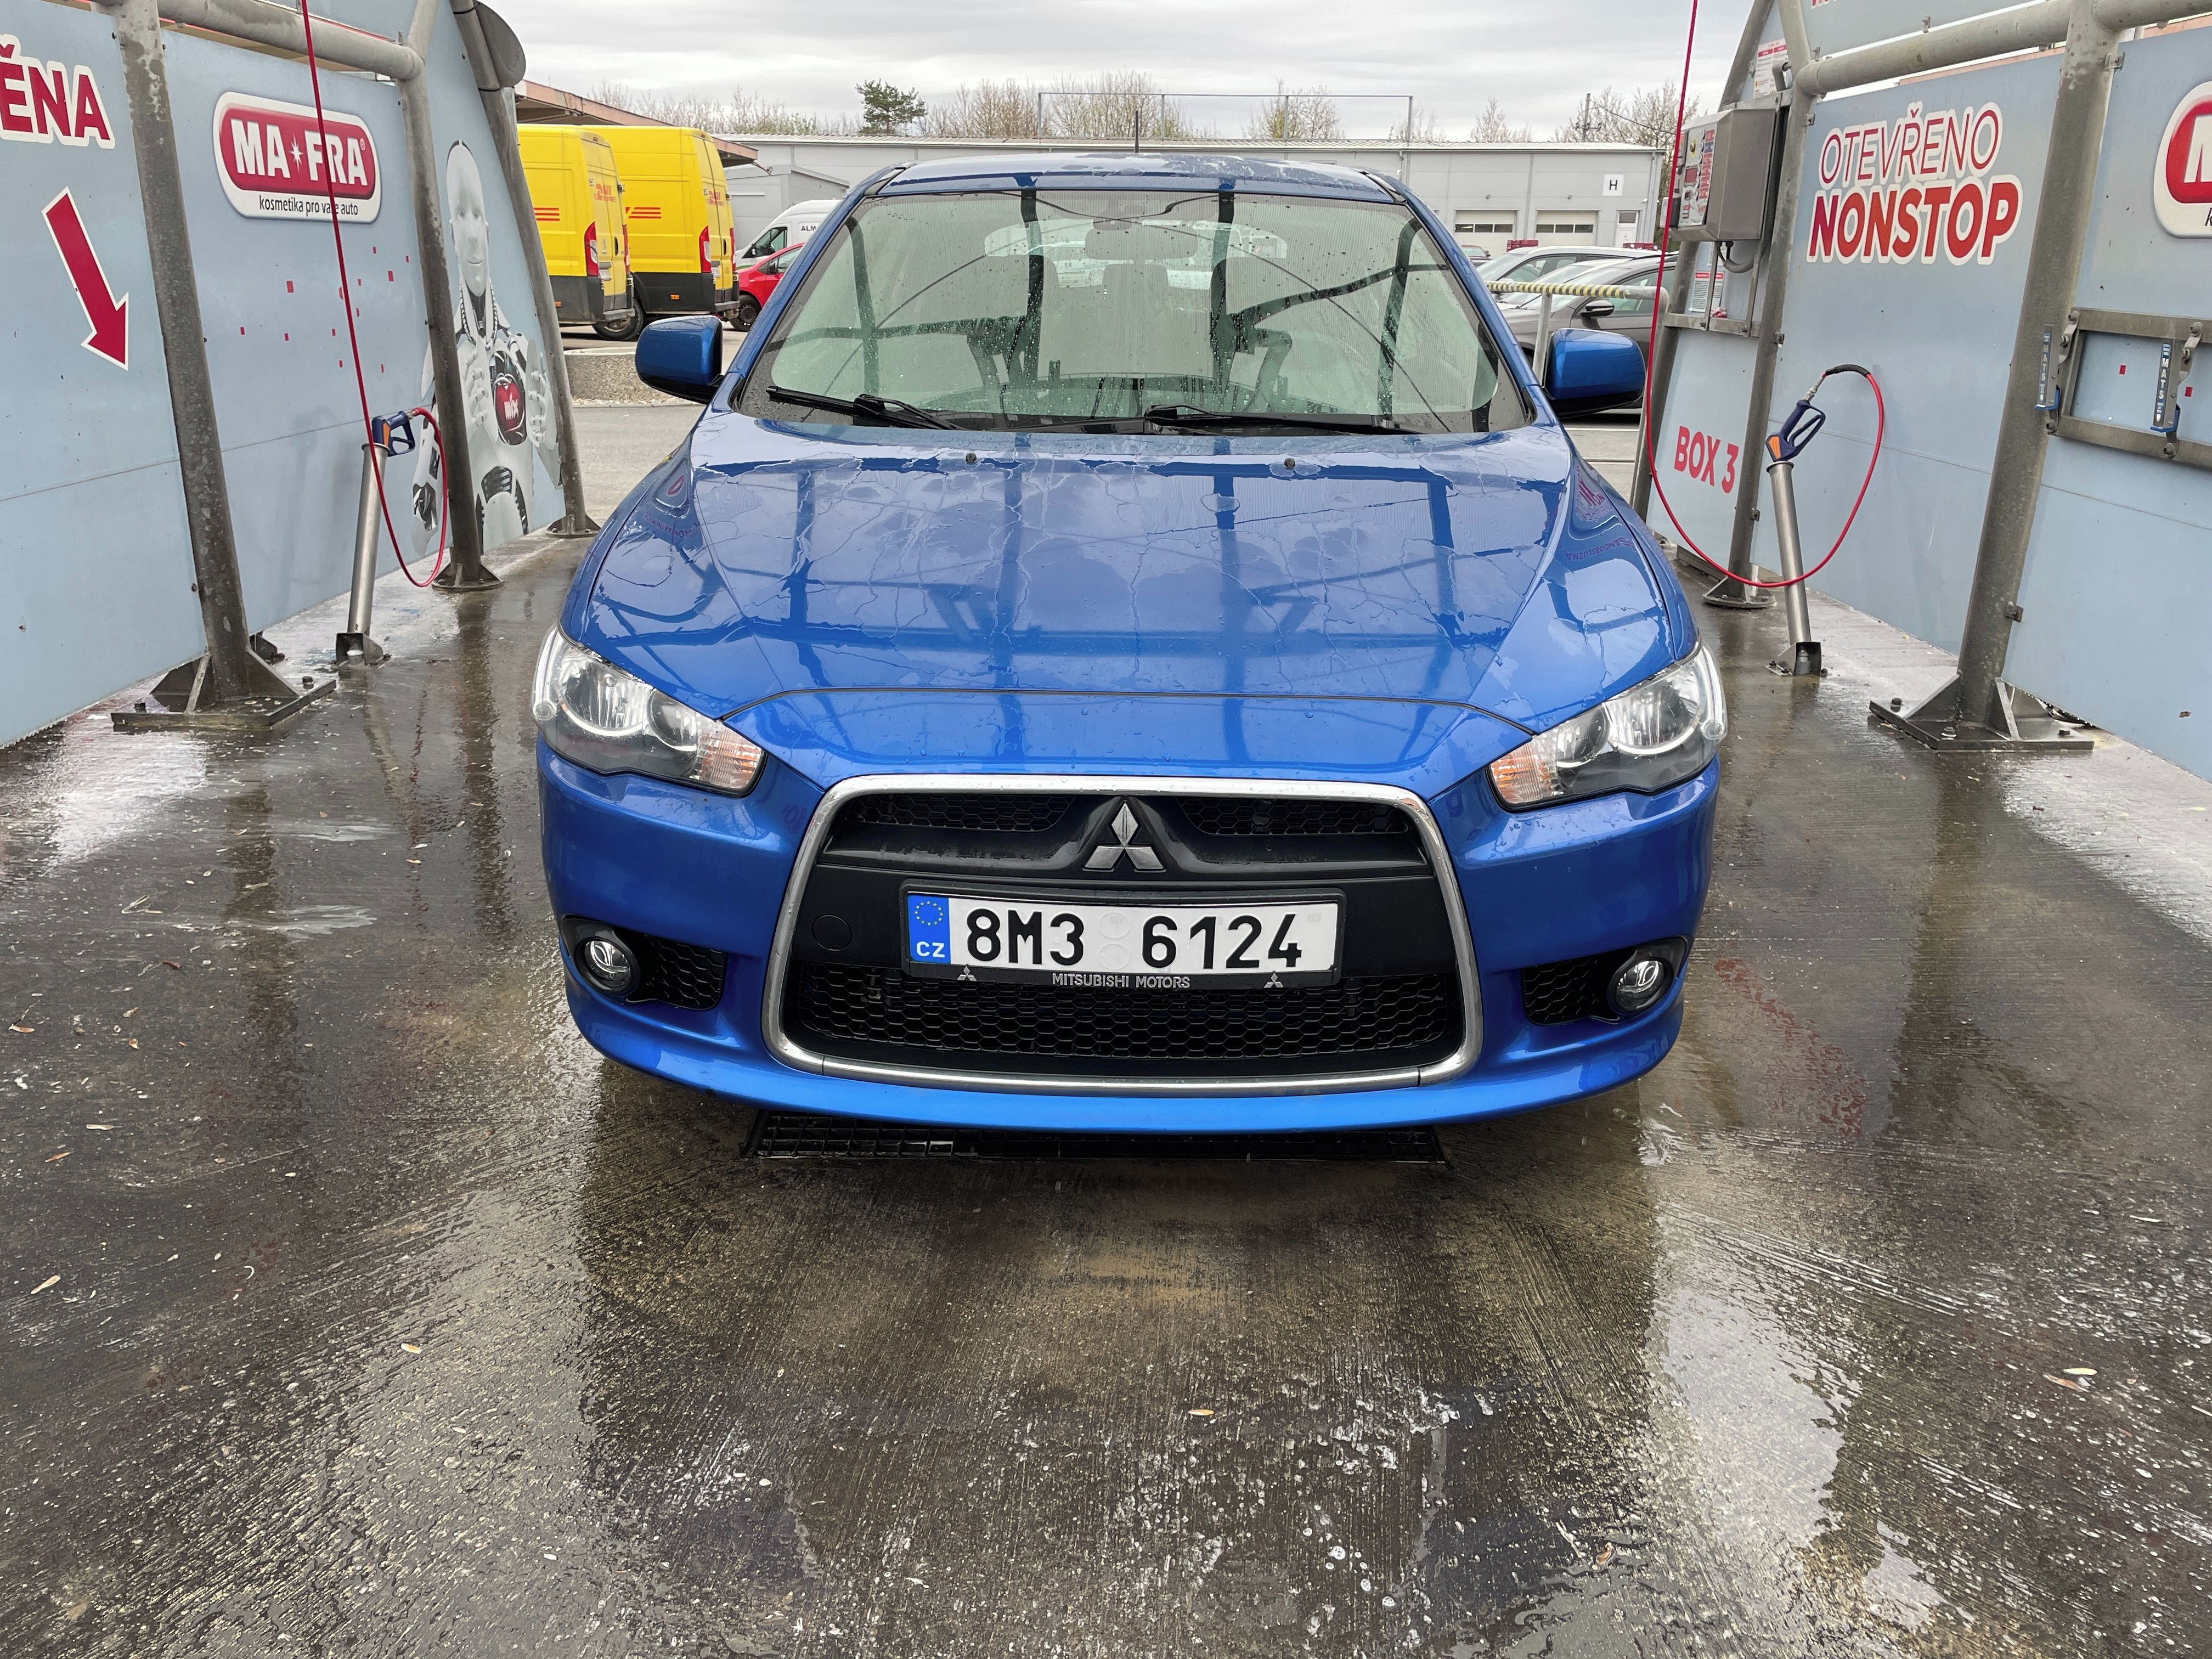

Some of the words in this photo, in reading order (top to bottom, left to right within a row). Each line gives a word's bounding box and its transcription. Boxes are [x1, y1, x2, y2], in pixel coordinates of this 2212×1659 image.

[1821, 108, 1999, 184] OTEVŘENO
[259, 195, 303, 212] kosmetika
[306, 201, 319, 217] pro
[321, 202, 339, 215] vae
[341, 203, 358, 215] auto
[1609, 179, 1618, 190] H
[1809, 182, 2019, 258] NONSTOP
[2159, 357, 2170, 400] MATS
[1674, 425, 1721, 487] BOX
[1722, 443, 1739, 494] 3
[916, 941, 945, 958] CZ
[967, 908, 1084, 966] 8M3
[1142, 913, 1302, 969] 6124
[1052, 973, 1129, 988] MITSUBISHI
[1136, 975, 1190, 989] MOTORS
